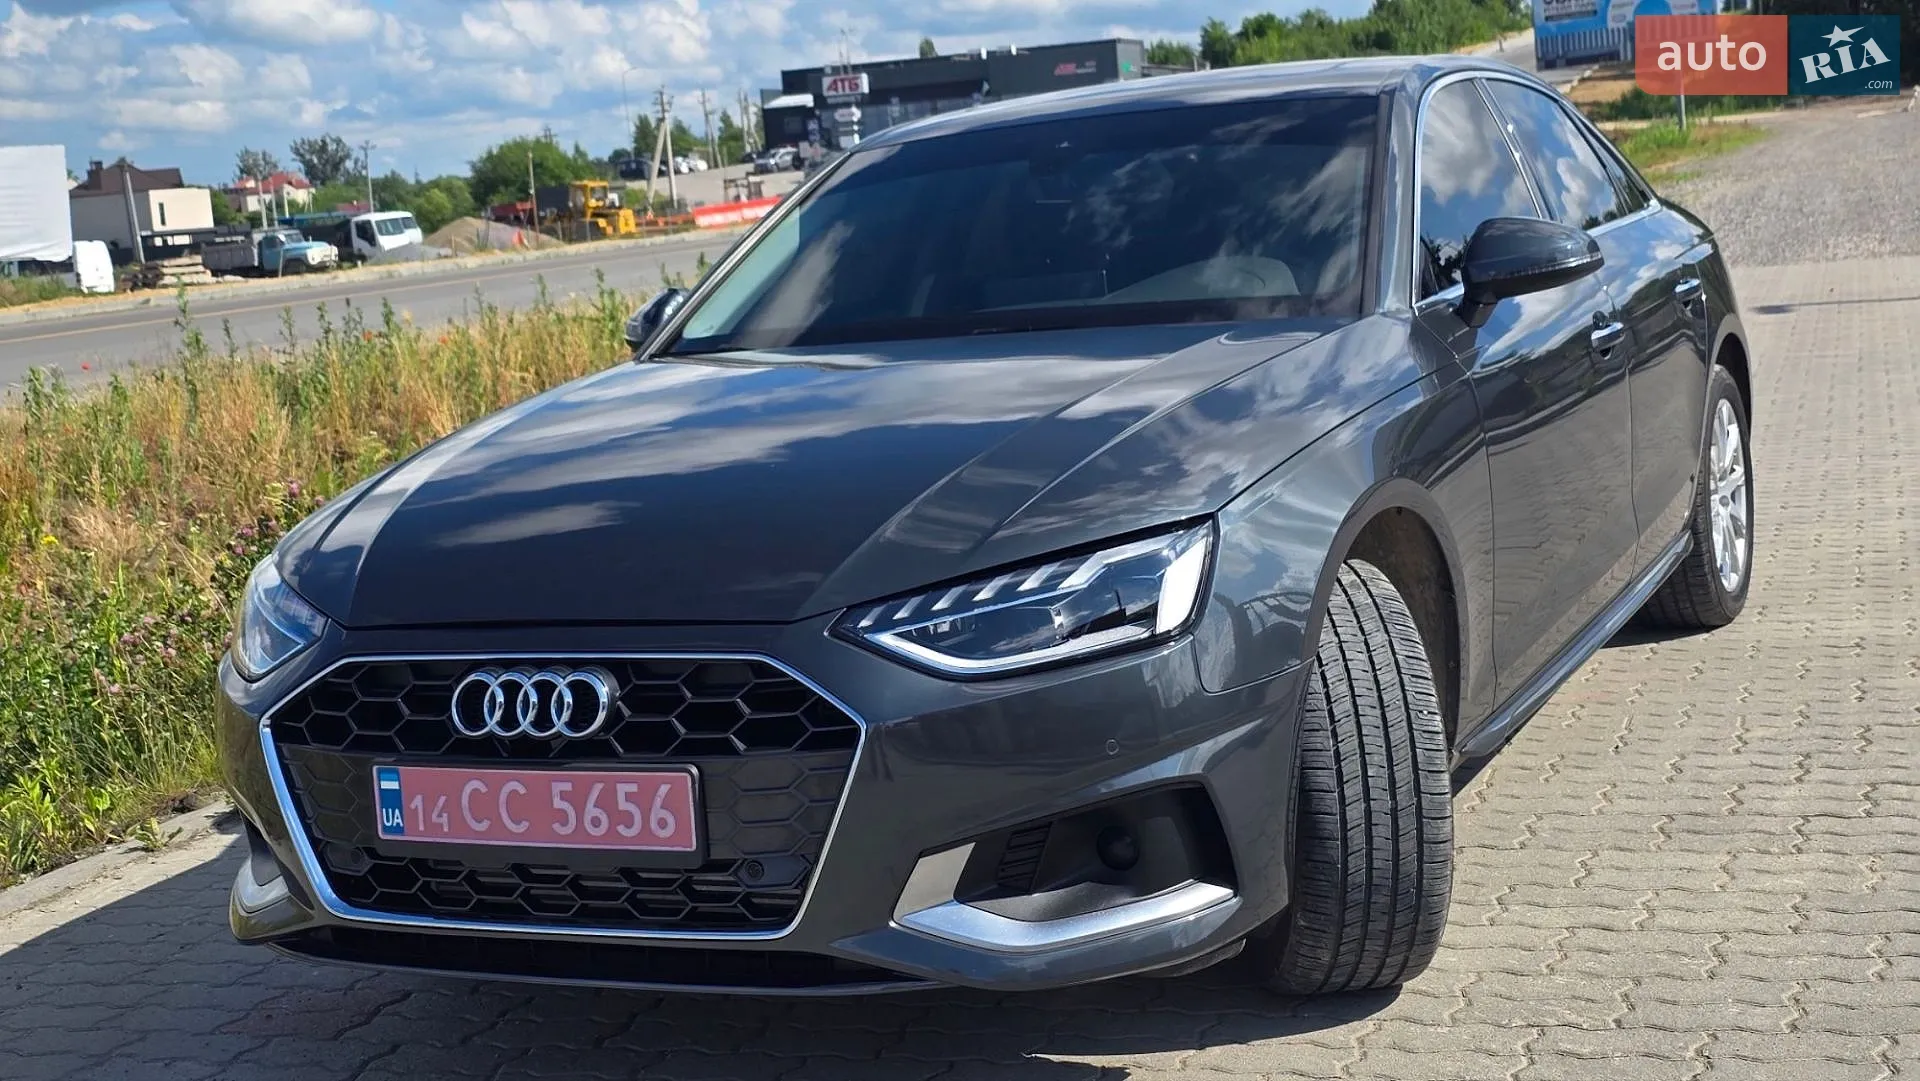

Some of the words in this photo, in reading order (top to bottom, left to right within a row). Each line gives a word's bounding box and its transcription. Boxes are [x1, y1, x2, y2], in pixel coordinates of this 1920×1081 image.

[382, 808, 404, 828] UA
[409, 794, 449, 832] 14
[461, 778, 530, 833] CC
[551, 781, 676, 838] 5656
